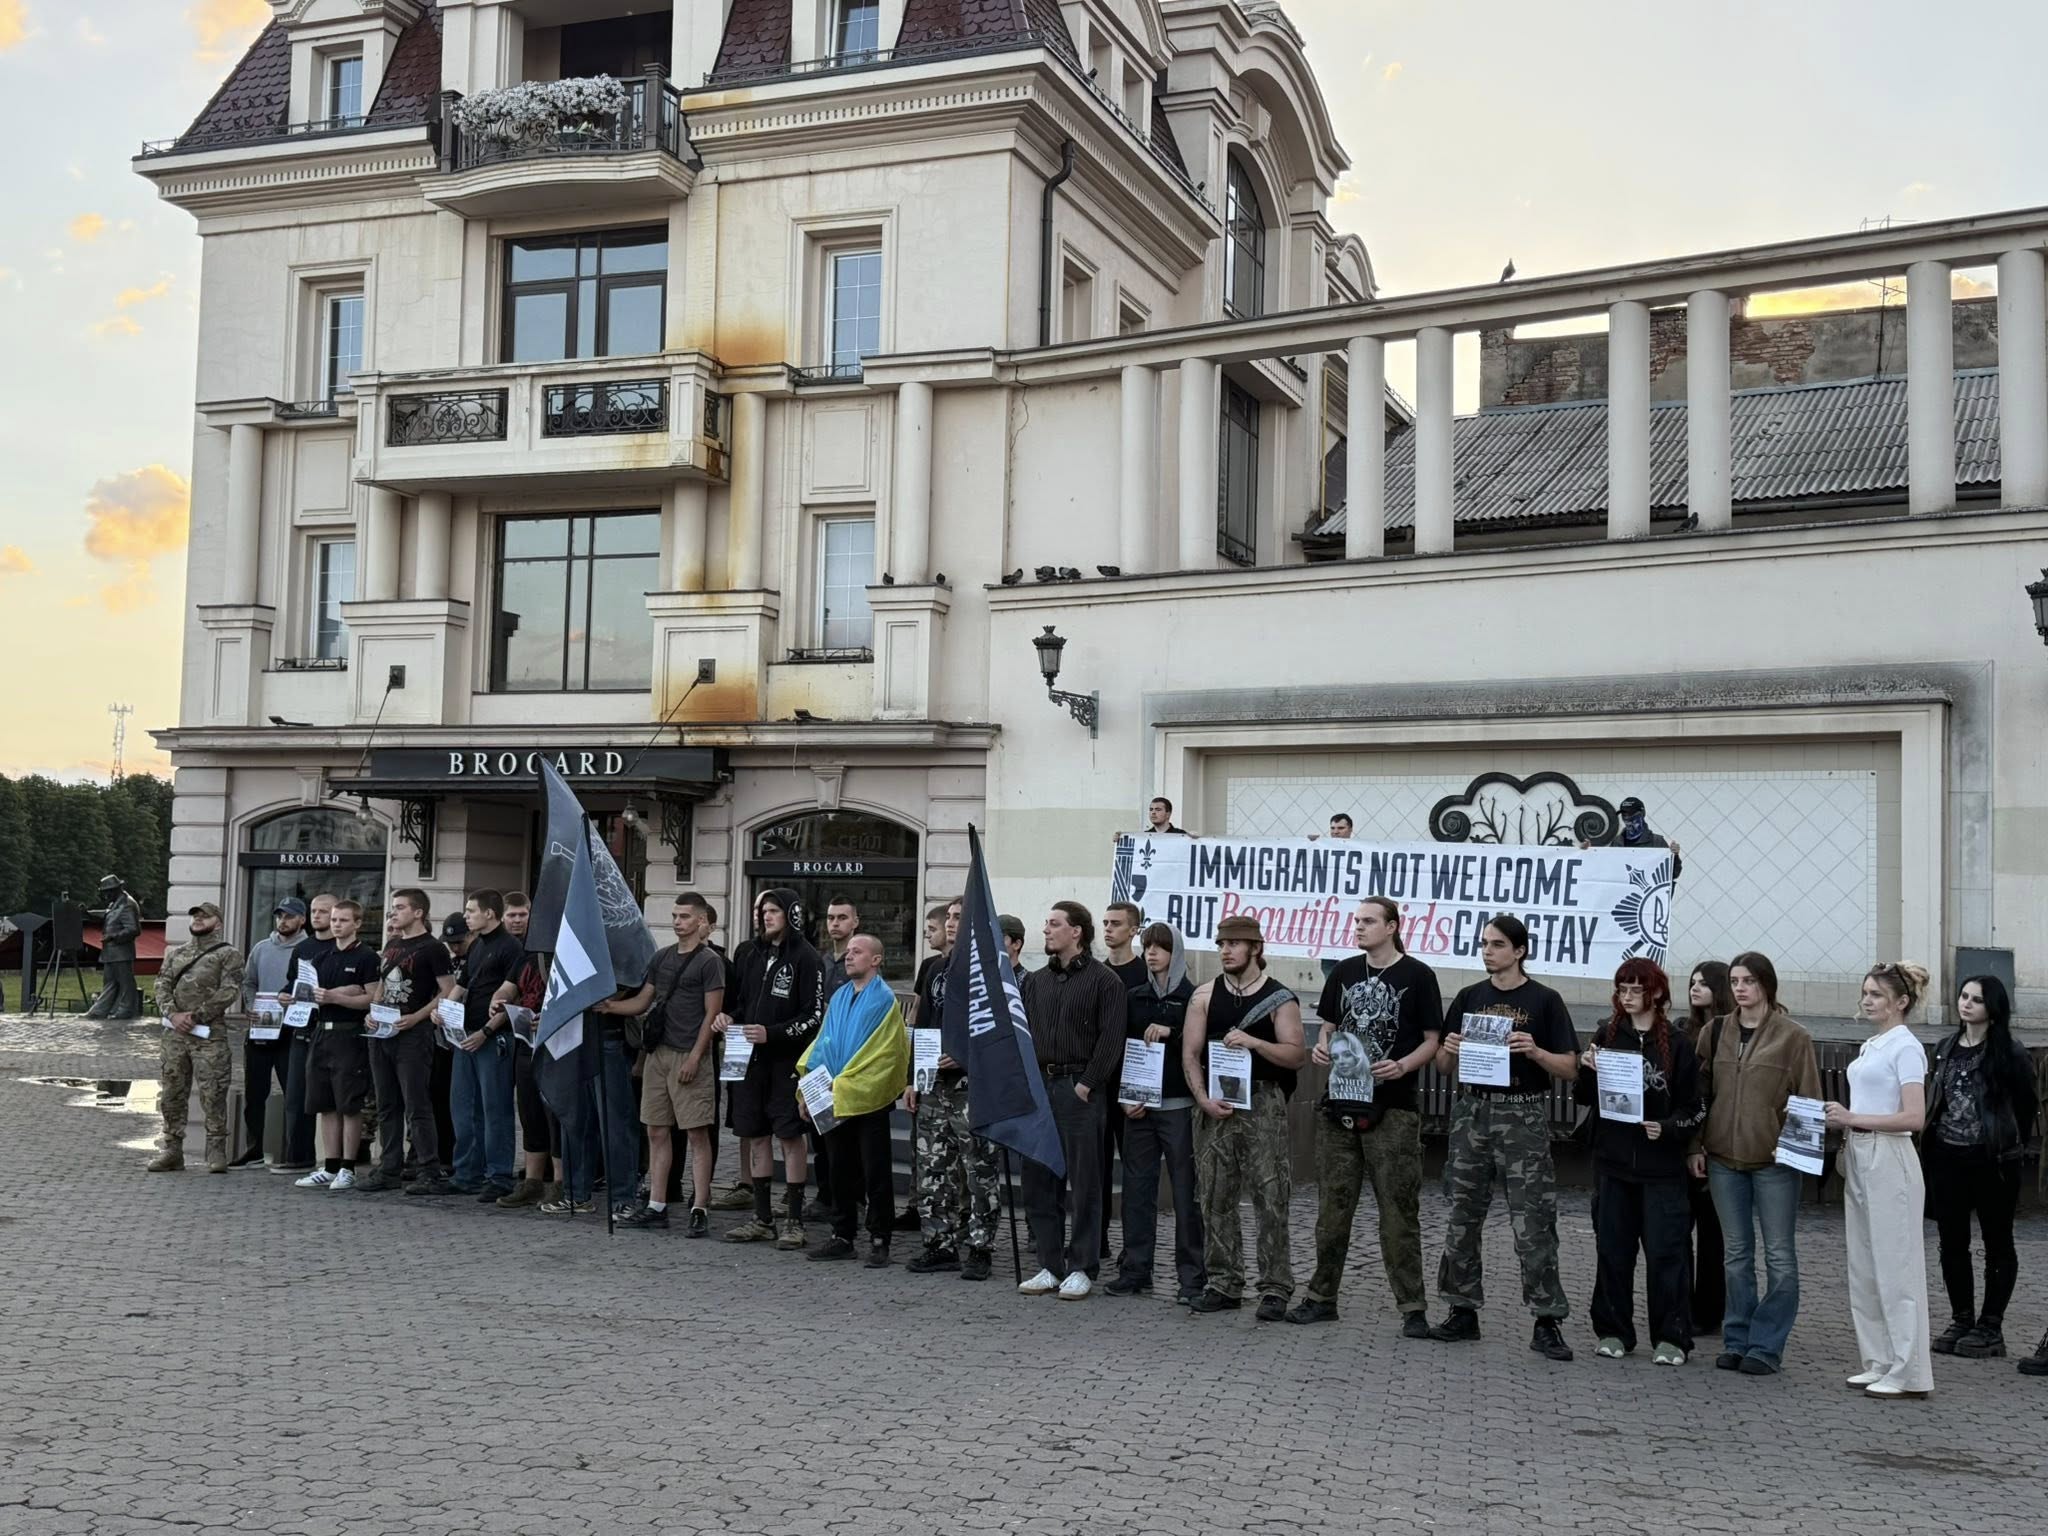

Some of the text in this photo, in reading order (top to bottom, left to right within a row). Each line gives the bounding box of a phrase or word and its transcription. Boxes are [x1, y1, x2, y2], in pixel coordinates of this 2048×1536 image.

[448, 751, 623, 775] BROCARD
[280, 854, 340, 864] BROCARD
[793, 862, 864, 873] BROCARD
[1189, 844, 1582, 906] IMMIGRANTS NOT WELCOME
[1167, 893, 1218, 939] BUT
[1397, 900, 1453, 953] irls
[1453, 910, 1514, 958] CA
[1525, 913, 1599, 965] STAY
[1336, 1077, 1366, 1087] WHITE
[1333, 1091, 1370, 1102] MATTER
